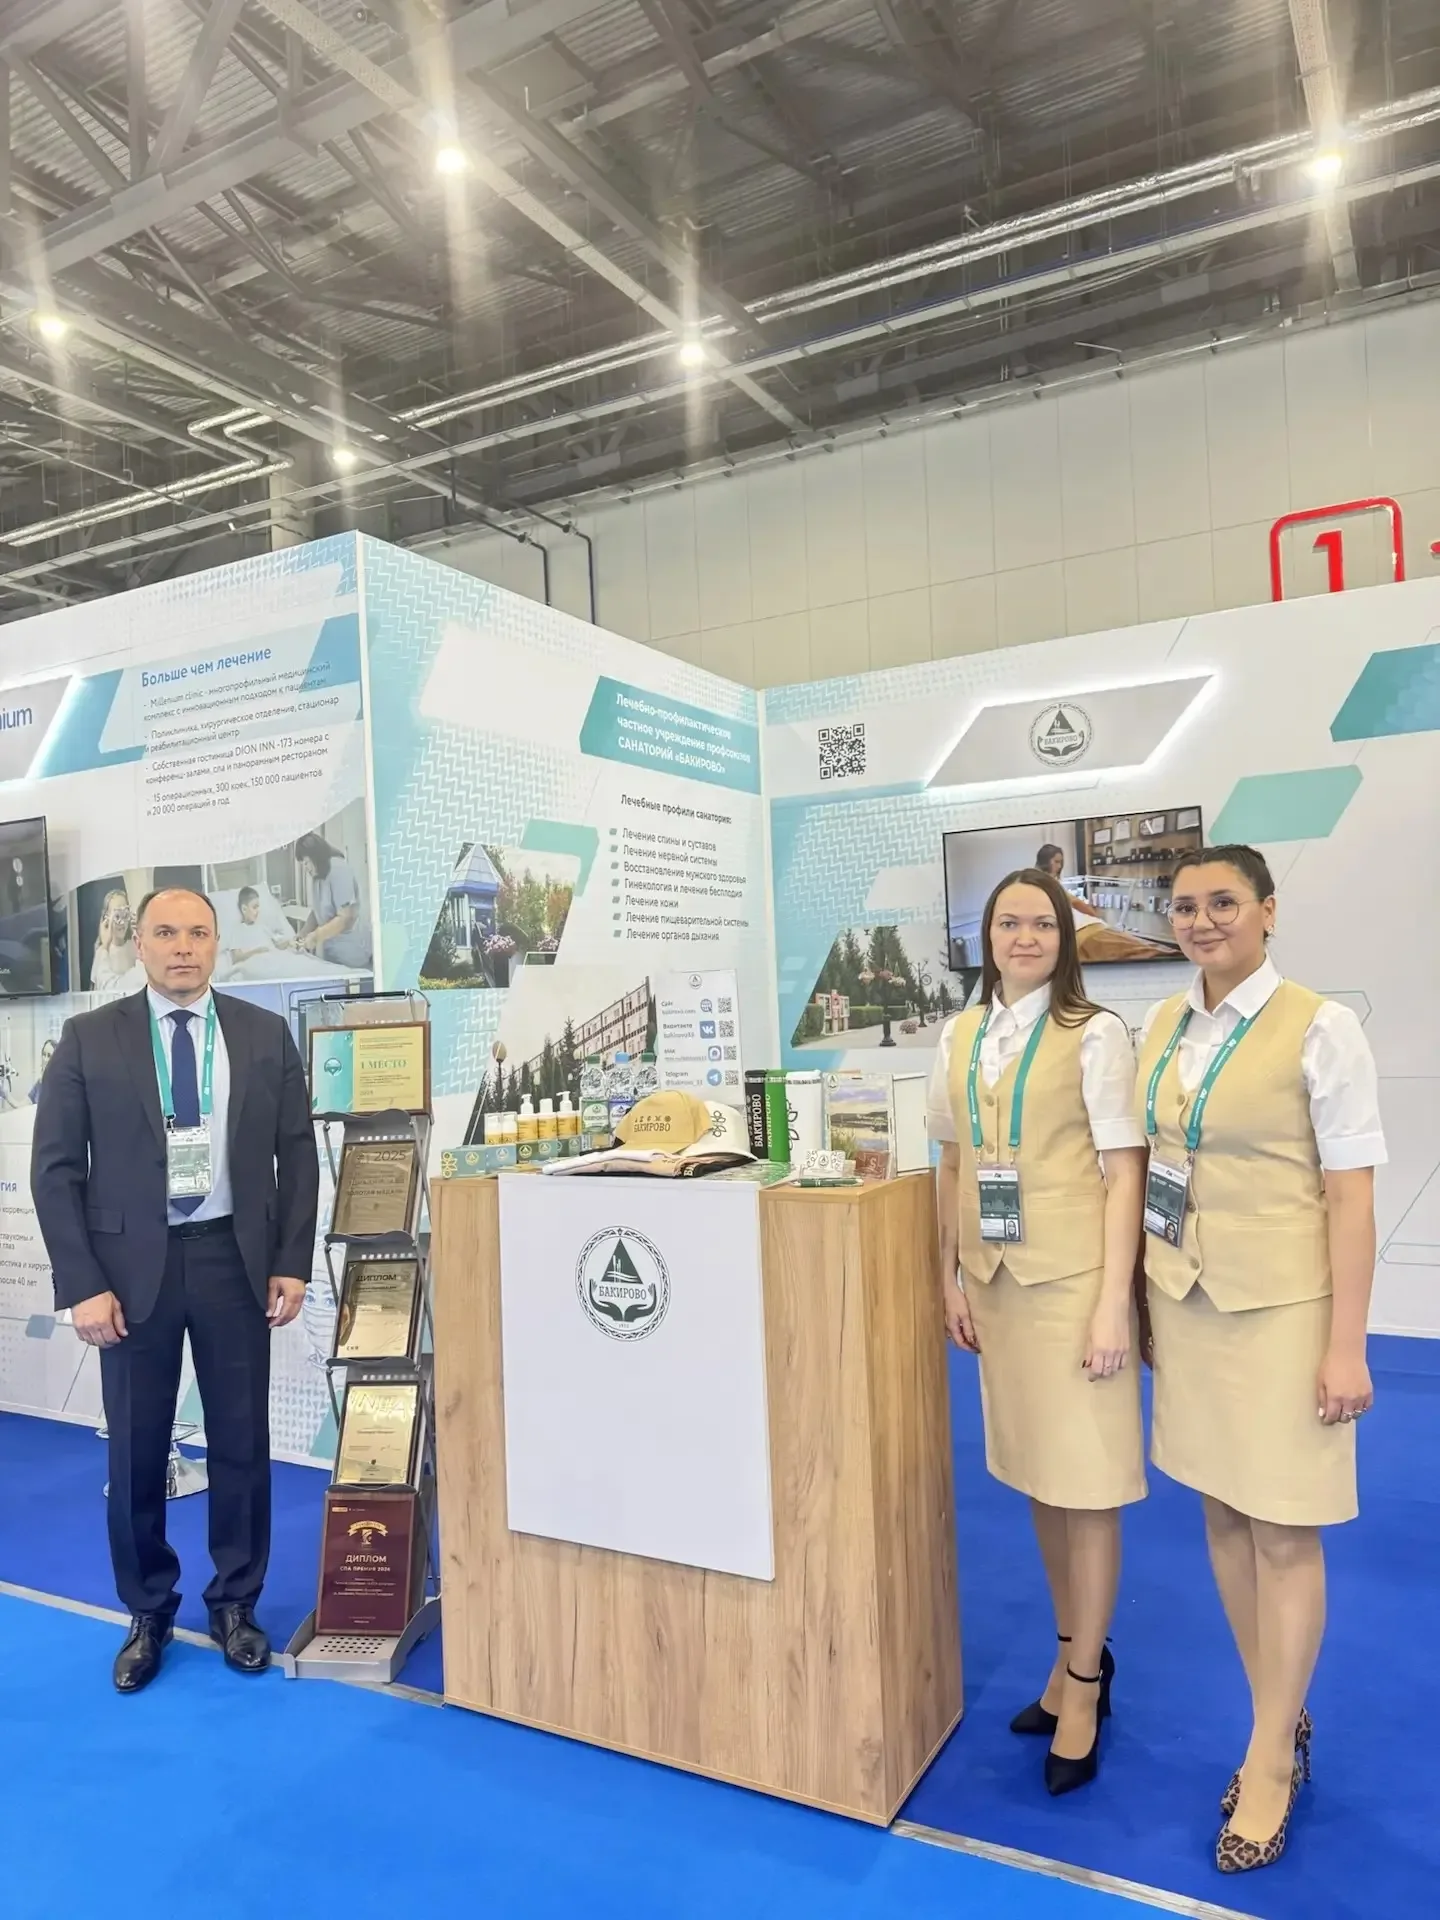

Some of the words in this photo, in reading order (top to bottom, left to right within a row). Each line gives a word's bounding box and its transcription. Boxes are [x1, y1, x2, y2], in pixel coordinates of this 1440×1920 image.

[141, 667, 188, 687] Больше
[190, 662, 214, 676] чем
[216, 648, 272, 670] лечение
[208, 672, 277, 695] многопрофильный
[278, 661, 331, 680] медицинский
[143, 709, 175, 721] комплекс
[182, 696, 239, 714] инновационным
[240, 689, 277, 701] подходом
[285, 678, 327, 692] пациентам
[151, 725, 199, 739] Поликлиника,
[200, 713, 254, 729] хирургическое
[254, 705, 297, 720] отделение,
[297, 697, 340, 711] стационар
[150, 732, 217, 754] реабилитационный
[217, 729, 240, 740] центр
[617, 716, 654, 736] частное
[654, 727, 706, 751] учреждение
[706, 742, 751, 763] профсоюзов
[152, 757, 196, 771] Собственная
[197, 750, 234, 763] гостиница
[235, 744, 257, 757] DION
[259, 740, 276, 752] INN
[277, 737, 293, 748] -173
[294, 734, 323, 745] номера
[213, 764, 225, 774] спа
[233, 756, 280, 770] панорамным
[281, 747, 328, 764] рестораном
[618, 735, 673, 761] САНАТОРИЙ
[674, 751, 726, 774] «БАКИРОВО»
[153, 792, 161, 802] 15
[161, 787, 215, 802] операционных,
[215, 782, 230, 793] 300
[251, 776, 264, 787] 150
[264, 773, 280, 785] 000
[281, 769, 323, 782] пациентов
[152, 806, 161, 816] 20
[162, 803, 176, 814] 000
[176, 798, 210, 812] операций
[217, 797, 230, 806] год
[621, 793, 661, 811] Лечебные
[662, 803, 695, 818] профили
[695, 810, 732, 825] санатория:
[622, 827, 656, 843] Лечение
[657, 835, 681, 846] спины
[687, 840, 717, 852] суставов
[623, 844, 657, 859] Лечение
[658, 851, 689, 863] нервной
[689, 855, 718, 867] системы
[623, 861, 685, 878] Восстановление
[685, 870, 718, 881] мужского
[718, 874, 747, 884] здоровья
[624, 877, 673, 892] Гинекология
[679, 885, 709, 896] лечение
[709, 885, 743, 898] бесплодия
[625, 894, 659, 907] Лечение
[659, 899, 679, 908] кожи
[625, 911, 660, 924] Лечение
[660, 915, 723, 927] пищеварительной
[723, 918, 749, 928] системы
[626, 928, 660, 940] Лечение
[661, 931, 690, 942] органов
[690, 932, 720, 942] дыхания
[368, 1059, 408, 1069] МЕСТО
[752, 1093, 764, 1148] БАКИРОВО
[374, 1150, 406, 1161] 2025
[2, 1206, 35, 1215] коррекция
[17, 1277, 26, 1286] 40
[355, 1274, 397, 1282] ДИПЛОМ
[598, 1285, 648, 1301] БАКИРОВО
[345, 1554, 387, 1564] ДИПЛОМ
